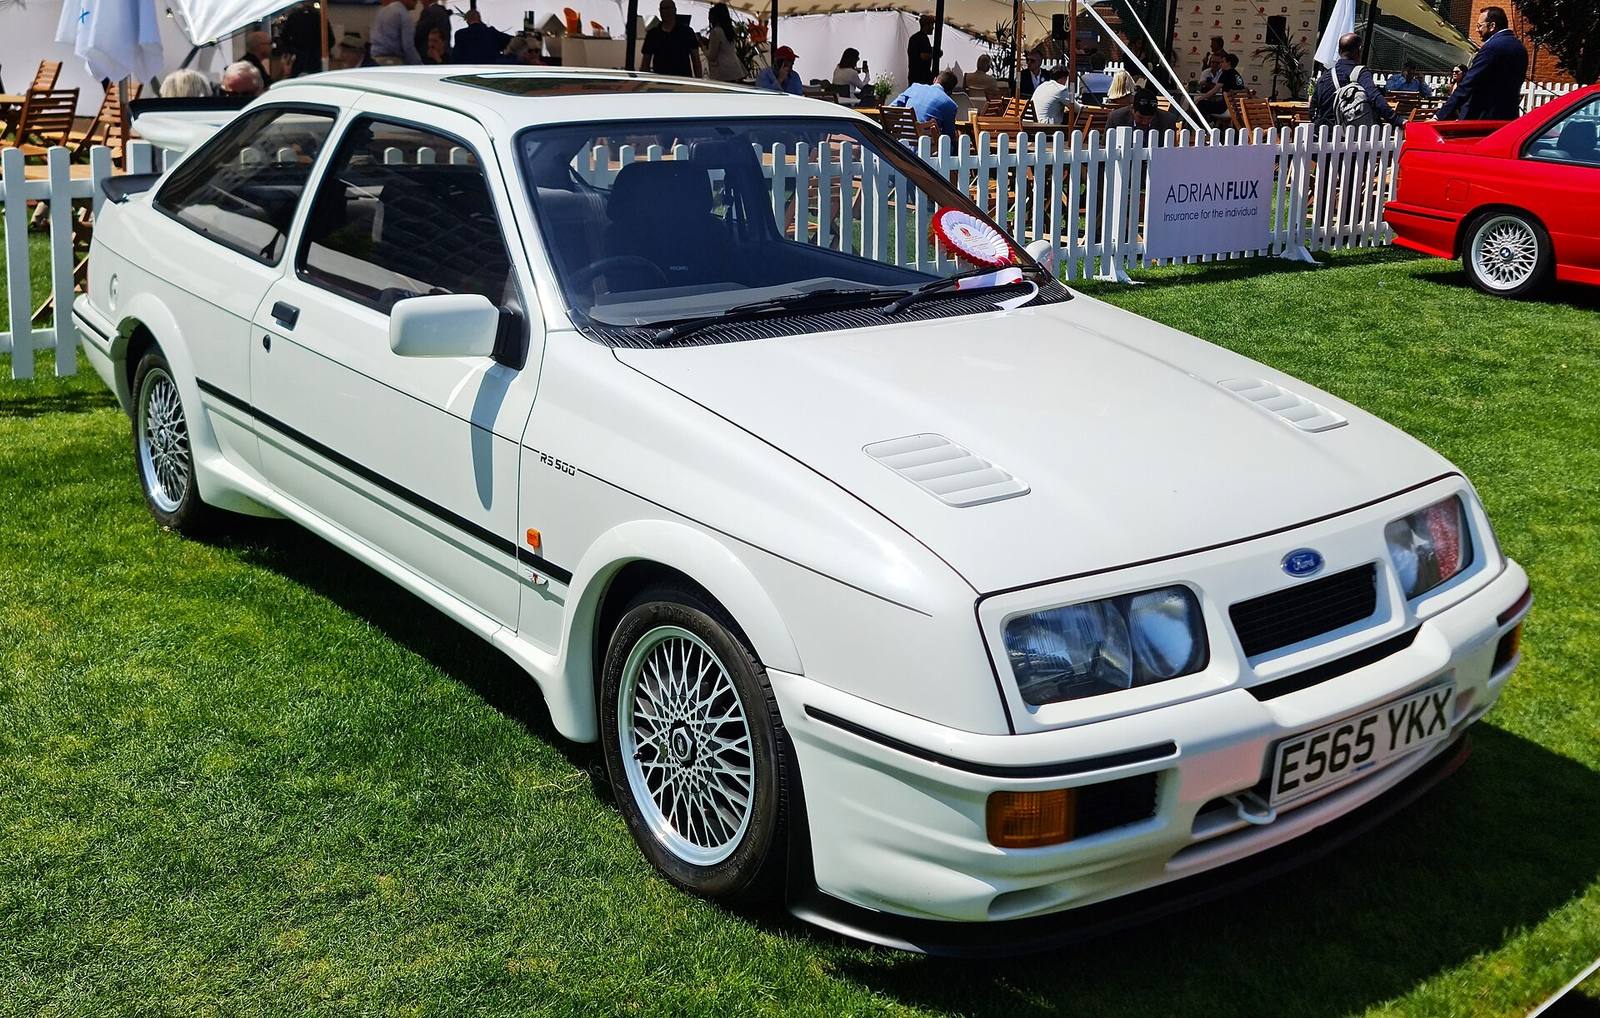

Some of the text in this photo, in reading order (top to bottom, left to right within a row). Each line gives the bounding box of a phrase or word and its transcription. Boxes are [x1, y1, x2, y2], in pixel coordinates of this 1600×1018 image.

[1163, 205, 1258, 222] Insurance for the individual
[540, 452, 576, 476] RS 500
[1291, 554, 1315, 571] Ford
[1276, 688, 1453, 794] E565 YKX
